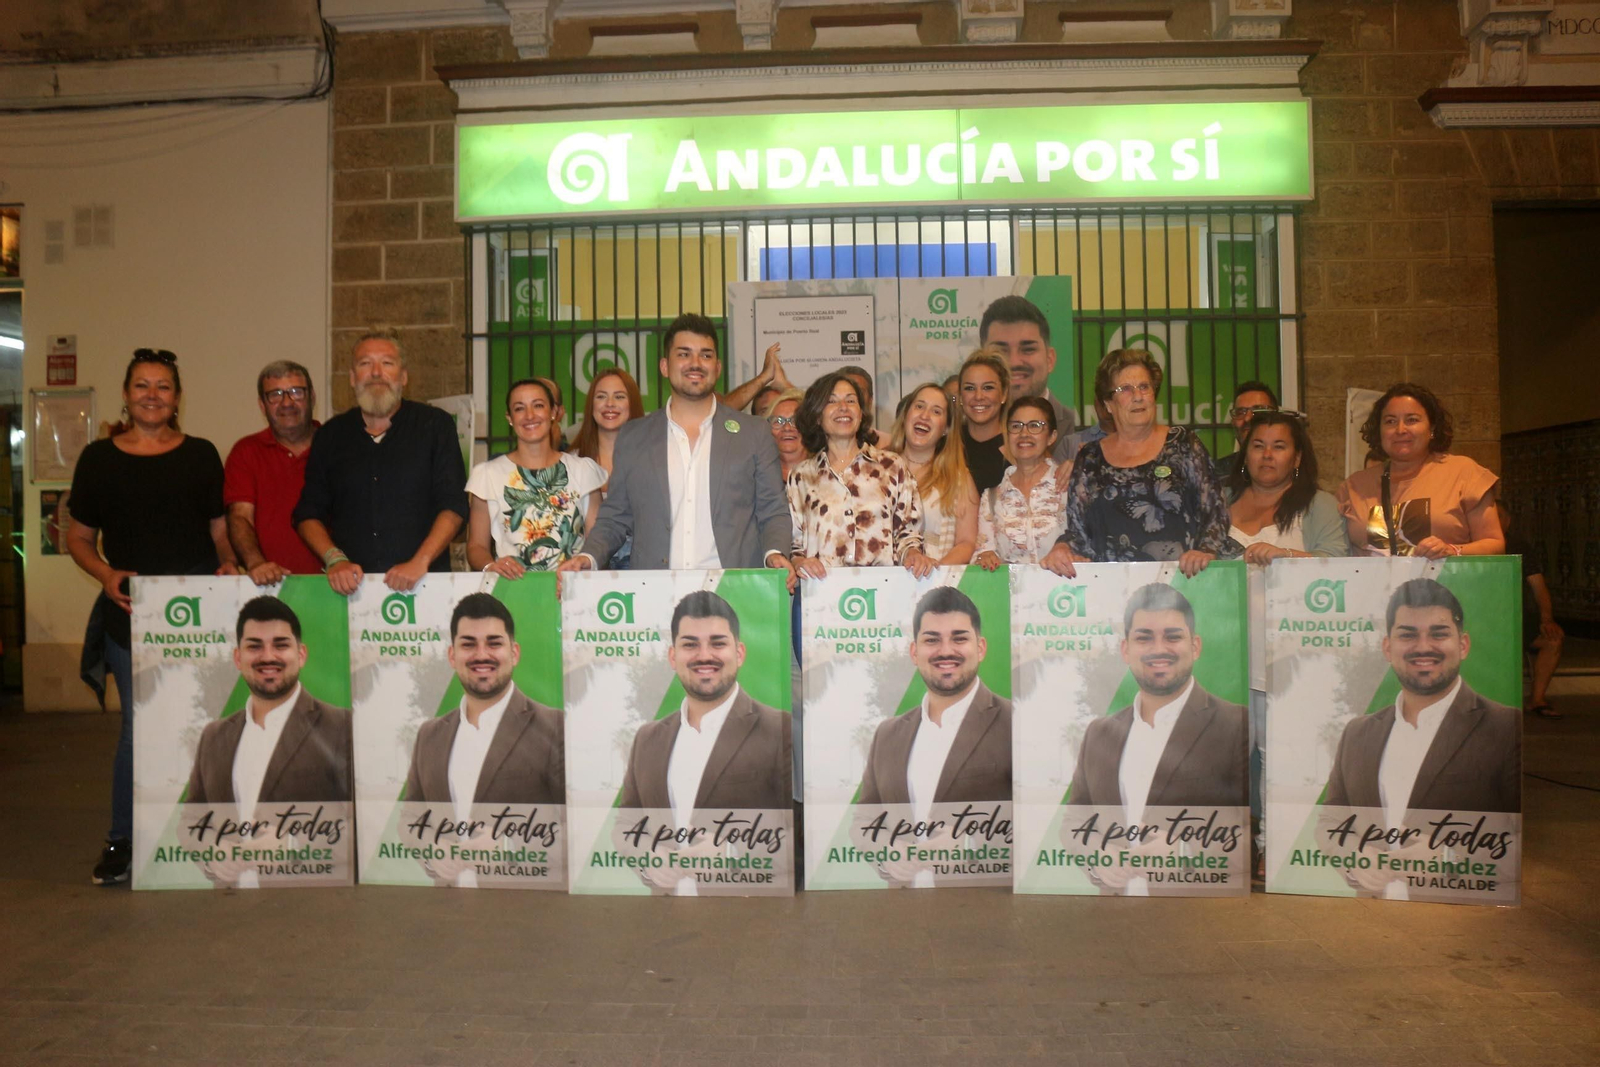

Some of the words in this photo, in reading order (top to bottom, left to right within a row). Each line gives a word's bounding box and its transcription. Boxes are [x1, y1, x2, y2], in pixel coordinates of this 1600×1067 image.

[664, 126, 1024, 193] ANDALUCÍA
[1036, 138, 1158, 183] POR
[1170, 121, 1223, 180] SÍ
[909, 316, 978, 328] ANDALUCÍA
[926, 331, 949, 339] POR
[952, 328, 962, 339] SÍ
[815, 624, 903, 639] ANDALUCÍA
[1024, 622, 1114, 636] ANDALUCÍA
[1279, 618, 1374, 632] ANDALUCÍA
[143, 630, 226, 644] ANDALUCÍA
[361, 628, 441, 642] ANDALUCÍA
[574, 628, 661, 642] ANDALUCÍA
[1302, 636, 1332, 647] POR
[1338, 633, 1351, 647] SÍ
[163, 648, 191, 658] POR
[195, 644, 206, 657] SÍ
[380, 646, 407, 656] POR
[411, 643, 421, 656] SÍ
[595, 646, 624, 657] POR
[628, 643, 640, 657] SÍ
[836, 643, 865, 653] POR
[870, 639, 881, 653] SÍ
[1045, 640, 1075, 651] POR
[1080, 637, 1091, 650] SÍ
[188, 811, 214, 842] A
[216, 819, 269, 845] por
[276, 805, 344, 844] todas
[408, 809, 432, 839] A
[435, 818, 484, 844] por
[491, 806, 558, 847] todas
[862, 811, 888, 842] A
[890, 819, 944, 846] por
[1072, 813, 1099, 845] A
[1103, 822, 1159, 851] por
[1166, 809, 1242, 852] todas
[623, 816, 649, 847] A
[652, 825, 706, 852] por
[713, 812, 785, 853] todas
[1327, 814, 1357, 847] A
[1359, 824, 1421, 853] por
[1429, 813, 1512, 859] todas
[154, 847, 225, 862] Alfredo
[232, 845, 332, 862] Fernández
[379, 843, 445, 860] Alfredo
[451, 845, 547, 863] Fernández
[828, 847, 900, 863] Alfredo
[907, 844, 1010, 861] Fernández
[1037, 850, 1112, 867] Alfredo
[1120, 851, 1228, 869] Fernández
[591, 852, 663, 868] Alfredo
[669, 853, 773, 869] Fernández
[1290, 850, 1371, 869] Alfredo
[1378, 854, 1496, 876] Fernández
[257, 865, 274, 874] TU
[277, 864, 332, 875] ALCALDE
[475, 865, 490, 875] TU
[494, 866, 548, 876] ALCALDE
[933, 865, 949, 874] TU
[953, 863, 1009, 874] ALCALDE
[696, 873, 712, 882] TU
[716, 873, 772, 883] ALCALDE
[1146, 872, 1164, 882] TU
[1168, 873, 1228, 883] ALCALDE
[1407, 876, 1425, 887] TU
[1430, 878, 1495, 891] ALCALDE
